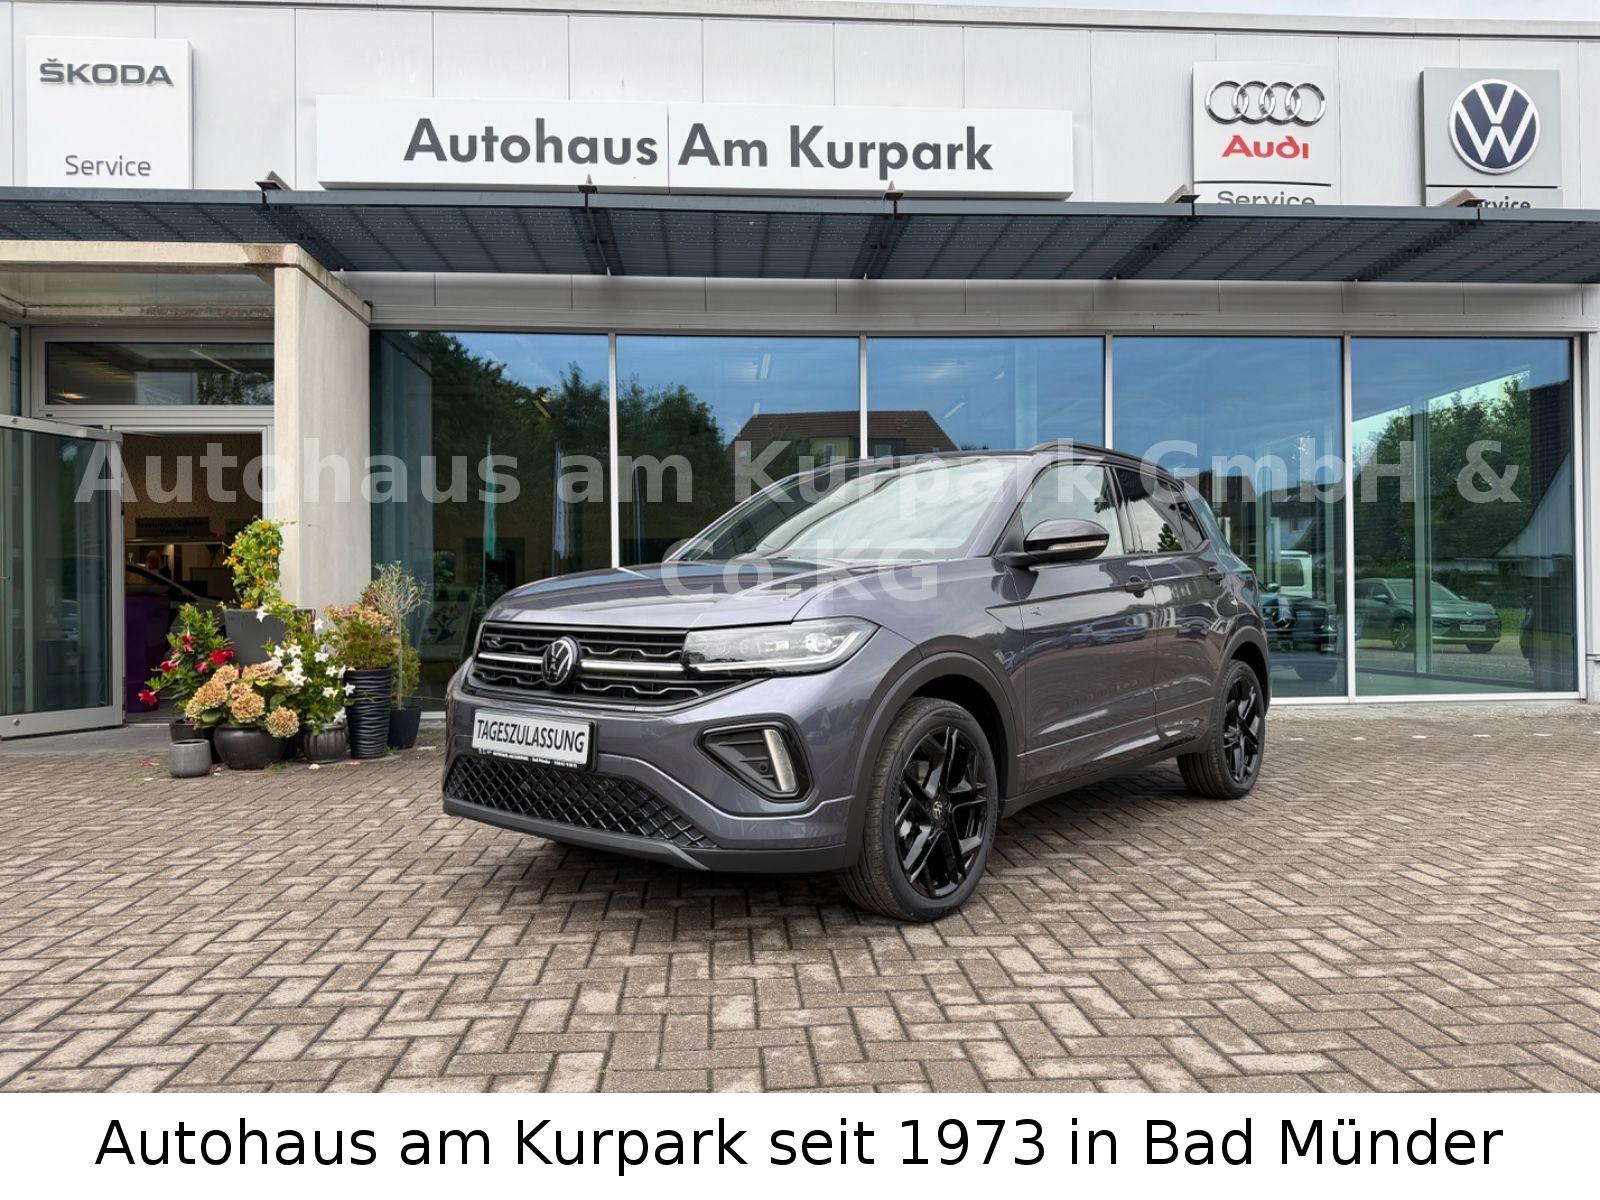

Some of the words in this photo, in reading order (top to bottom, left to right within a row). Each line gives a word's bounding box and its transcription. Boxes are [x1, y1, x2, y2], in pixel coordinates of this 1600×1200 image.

[39, 58, 173, 86] ŠKODA
[404, 118, 658, 166] Autohaus
[679, 124, 767, 166] Am
[791, 126, 993, 180] Kurpark
[1222, 135, 1309, 159] Audi
[65, 154, 152, 177] Service
[476, 718, 586, 754] TAGESZULASSUNG
